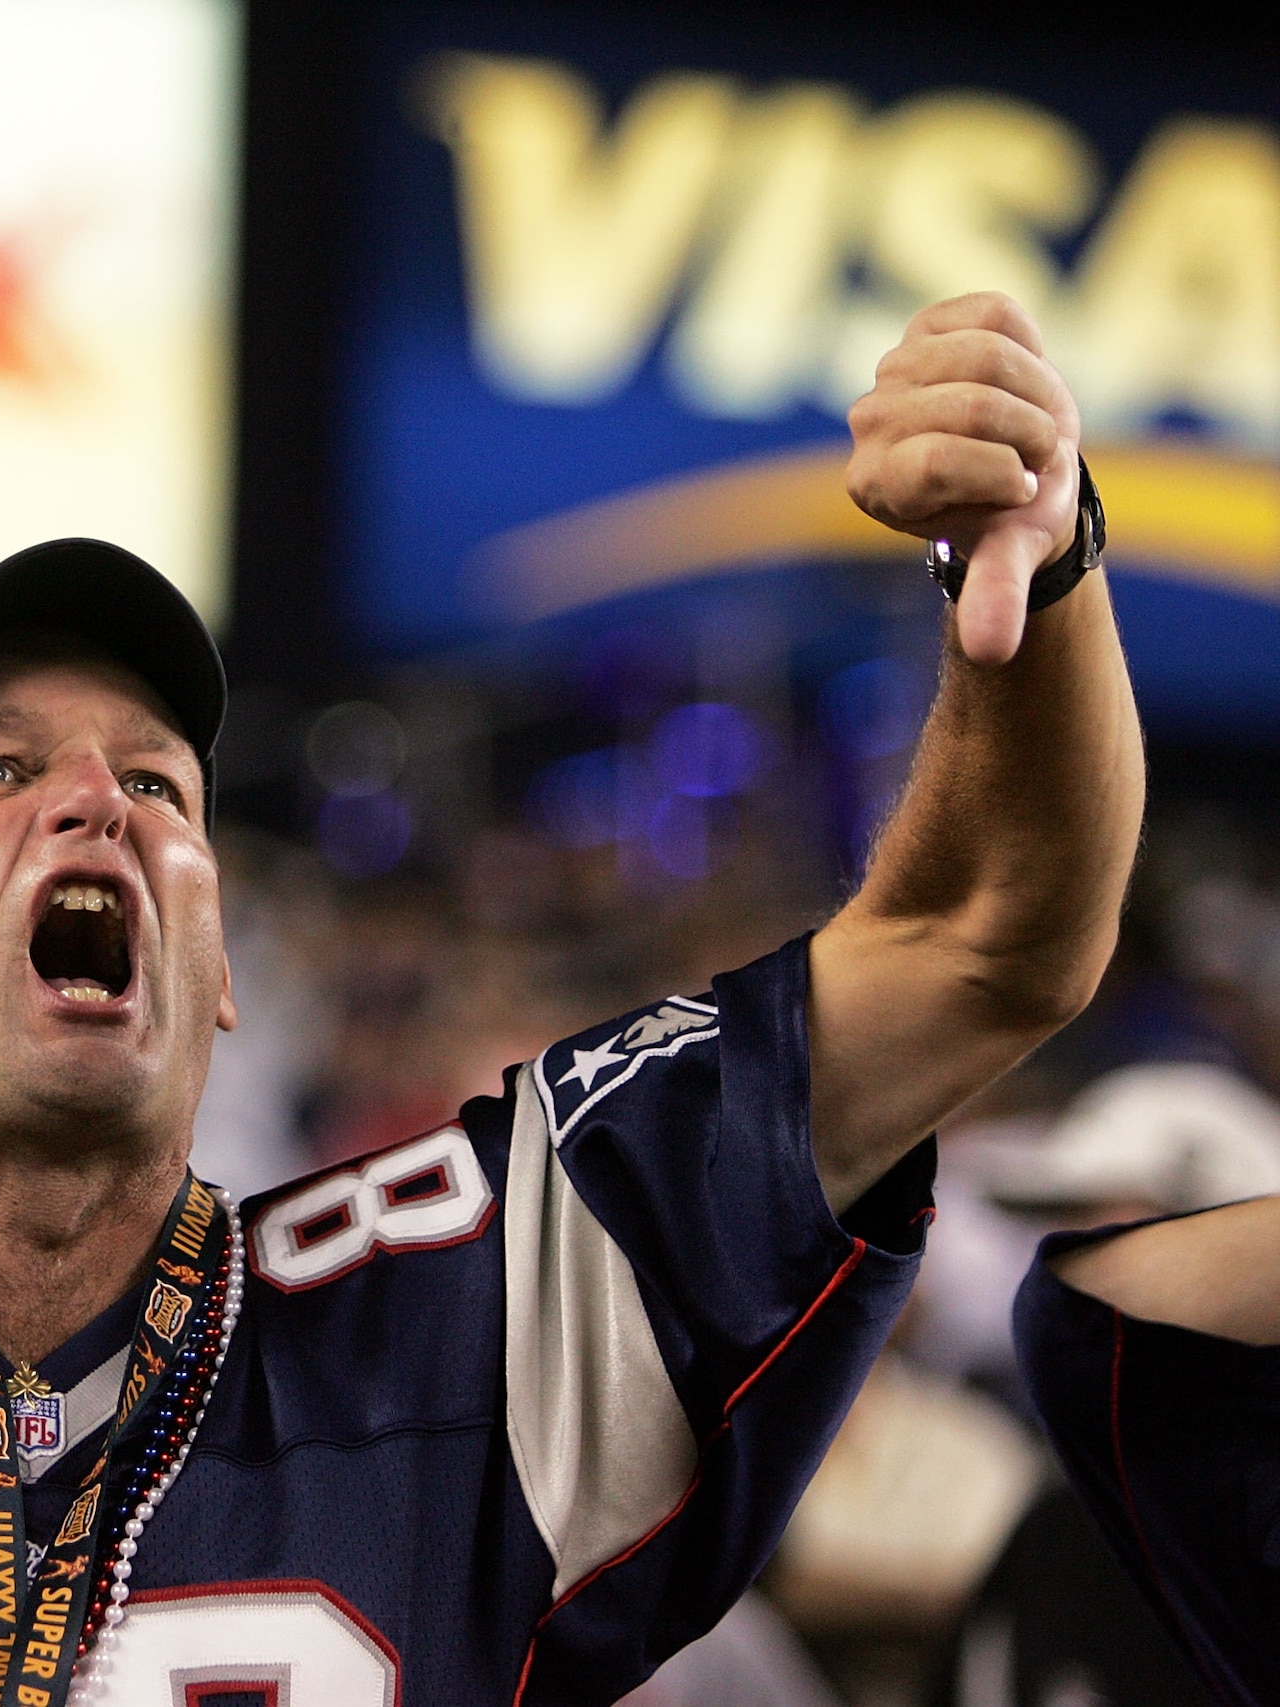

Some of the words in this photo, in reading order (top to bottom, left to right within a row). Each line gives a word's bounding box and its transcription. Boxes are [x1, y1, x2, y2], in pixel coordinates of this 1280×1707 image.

[428, 52, 1280, 432] VISA
[245, 1119, 498, 1294] 8
[22, 1587, 73, 1679] SUPER
